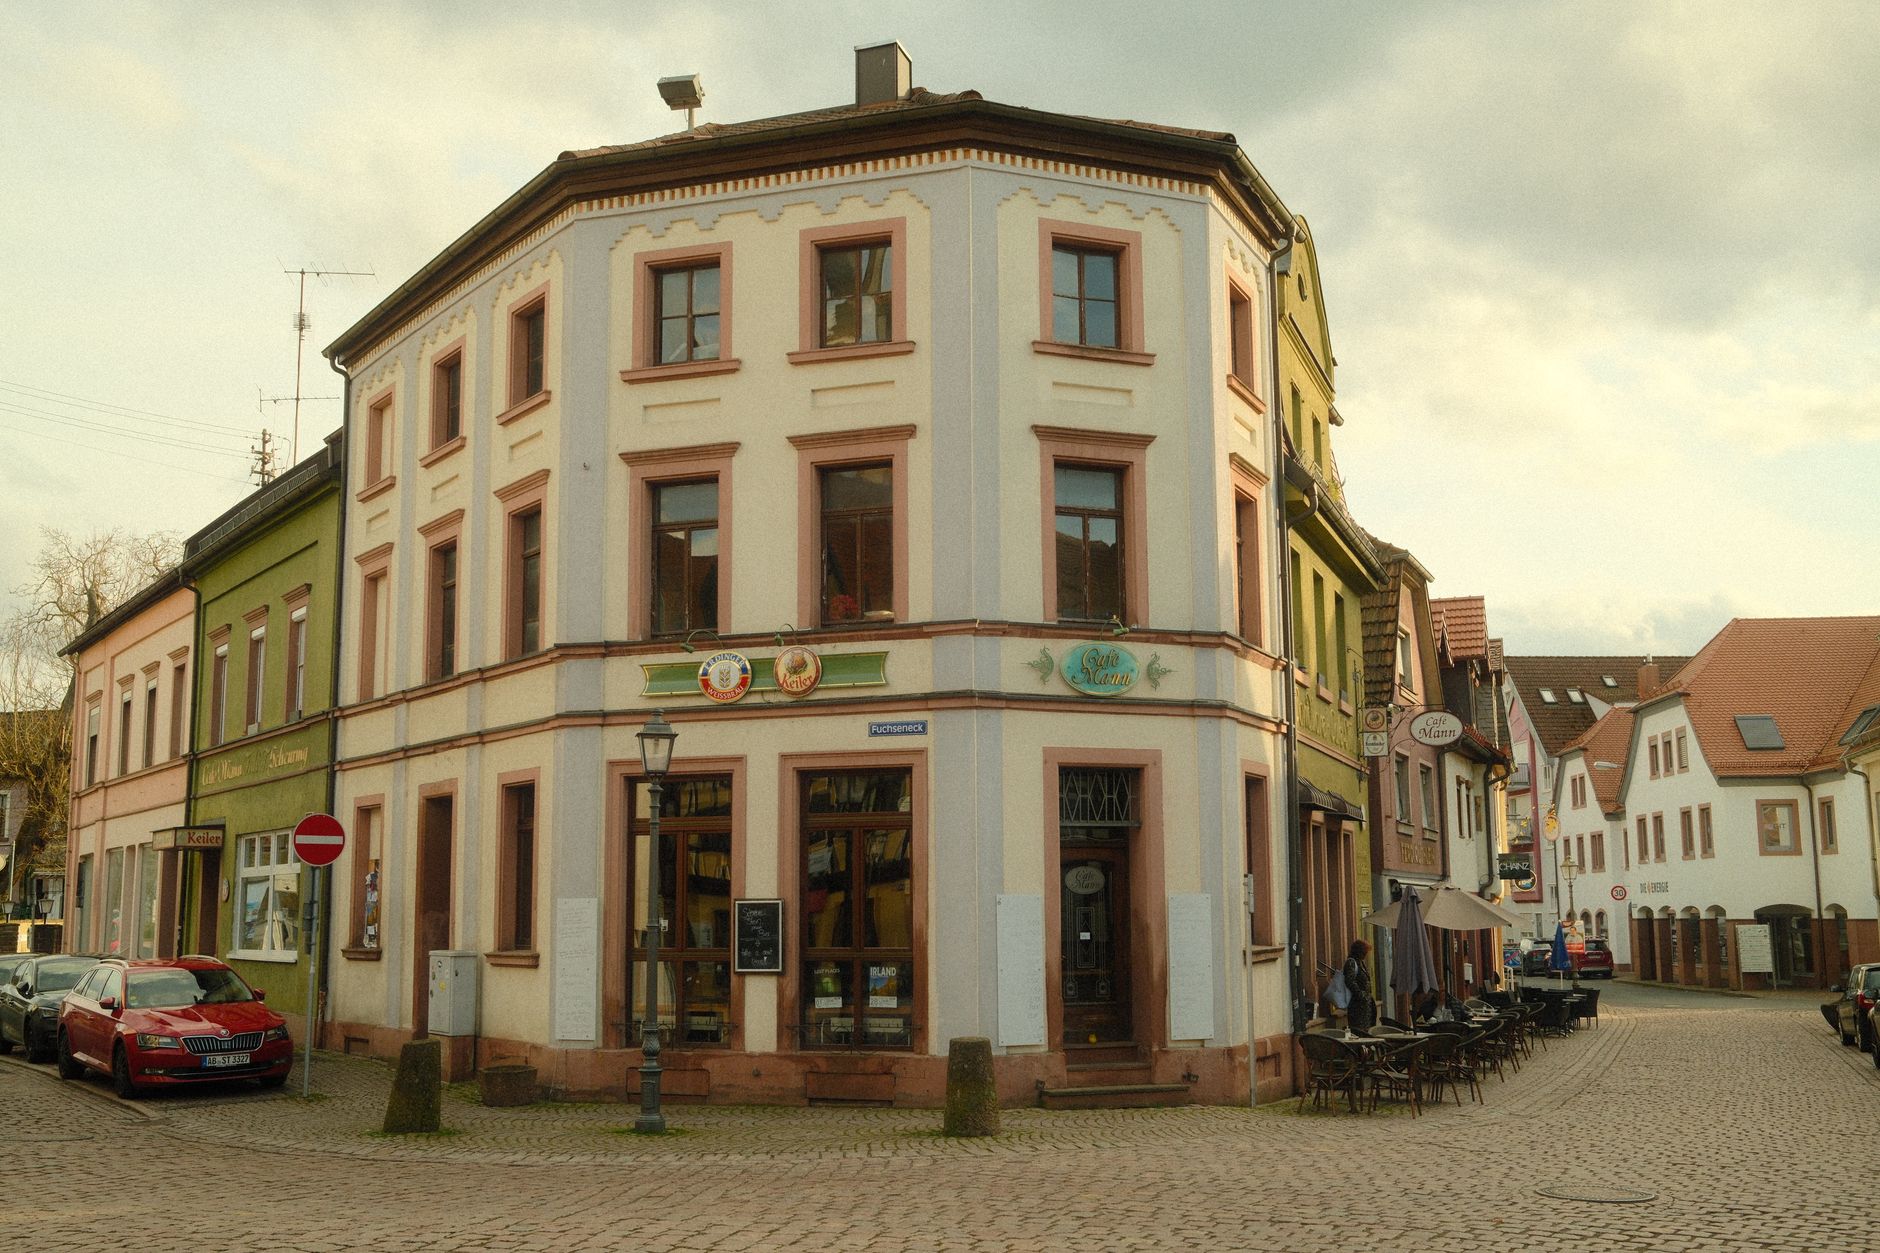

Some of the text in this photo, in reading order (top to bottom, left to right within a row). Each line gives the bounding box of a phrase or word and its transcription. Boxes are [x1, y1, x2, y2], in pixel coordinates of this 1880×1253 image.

[704, 652, 745, 671] ERDINGER
[1081, 648, 1120, 667] Café
[781, 673, 813, 689] Keiler
[1071, 666, 1132, 685] Mann
[1426, 714, 1447, 728] Café
[871, 723, 924, 734] Fuchseneck
[1418, 727, 1457, 739] Mann
[187, 831, 221, 844] Keiler
[1499, 862, 1530, 871] CHAINZ
[1614, 889, 1624, 897] 30
[1651, 882, 1669, 893] ENERGIE
[869, 966, 897, 977] IRLAND
[208, 1055, 249, 1065] AB ST 3327
